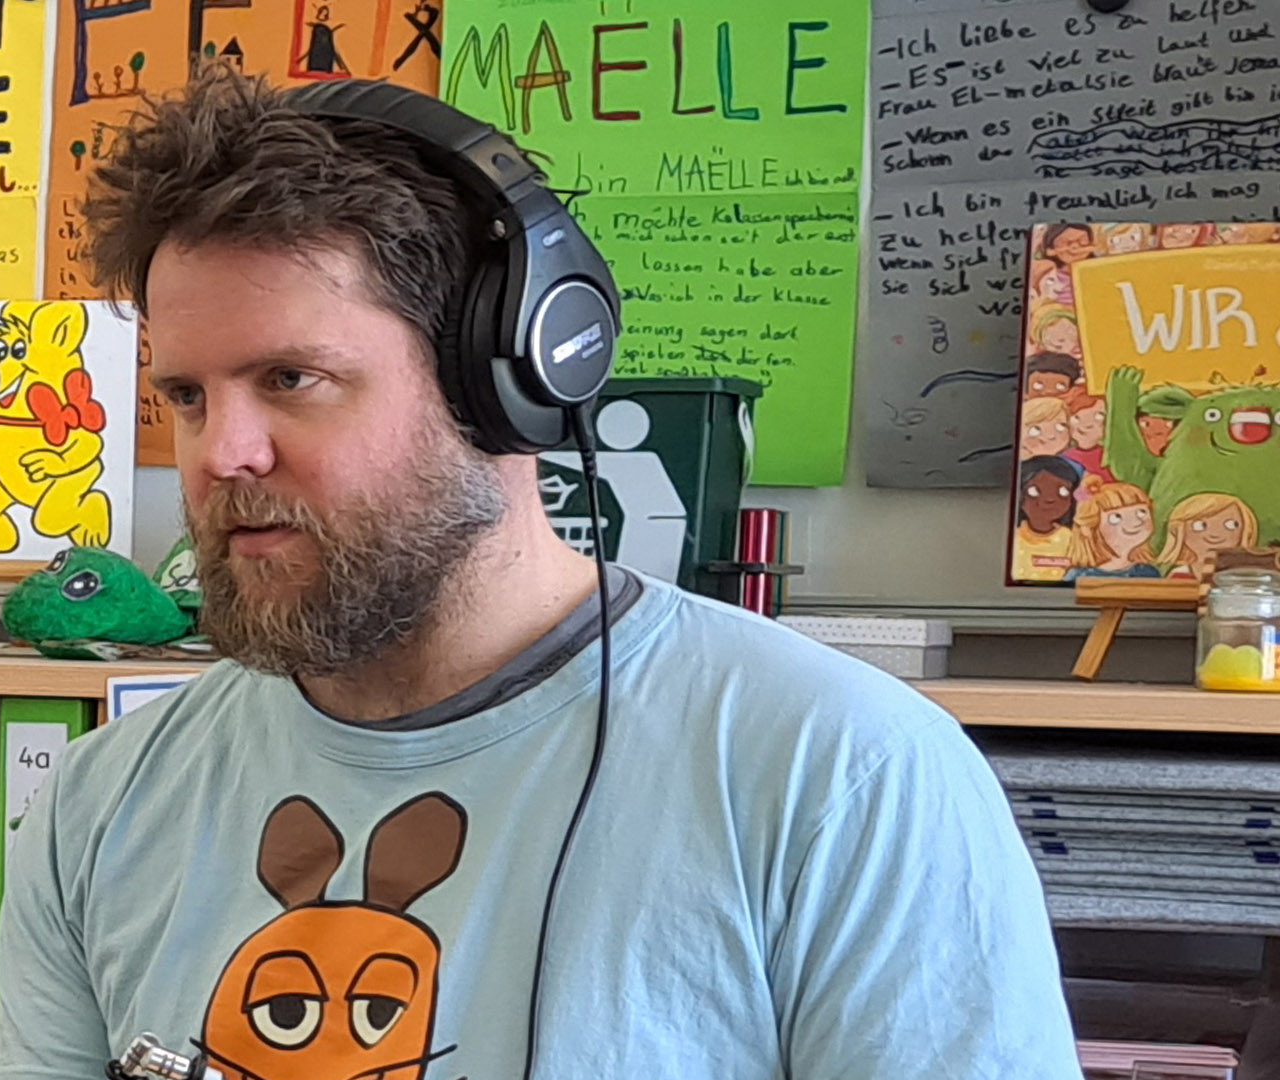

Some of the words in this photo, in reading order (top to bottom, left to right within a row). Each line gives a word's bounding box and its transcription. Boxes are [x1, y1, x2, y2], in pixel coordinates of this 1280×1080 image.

[1063, 13, 1097, 37] es
[1096, 45, 1135, 62] zu
[982, 119, 1012, 138] es
[1031, 113, 1071, 130] ein
[575, 152, 627, 195] bin
[655, 146, 779, 193] MAËLLE
[965, 190, 1002, 212] bin
[1212, 180, 1261, 200] mag
[613, 208, 703, 231] möchte
[878, 232, 923, 252] zu
[1116, 281, 1258, 355] WIR
[627, 318, 683, 344] einung
[19, 746, 50, 769] 4a
